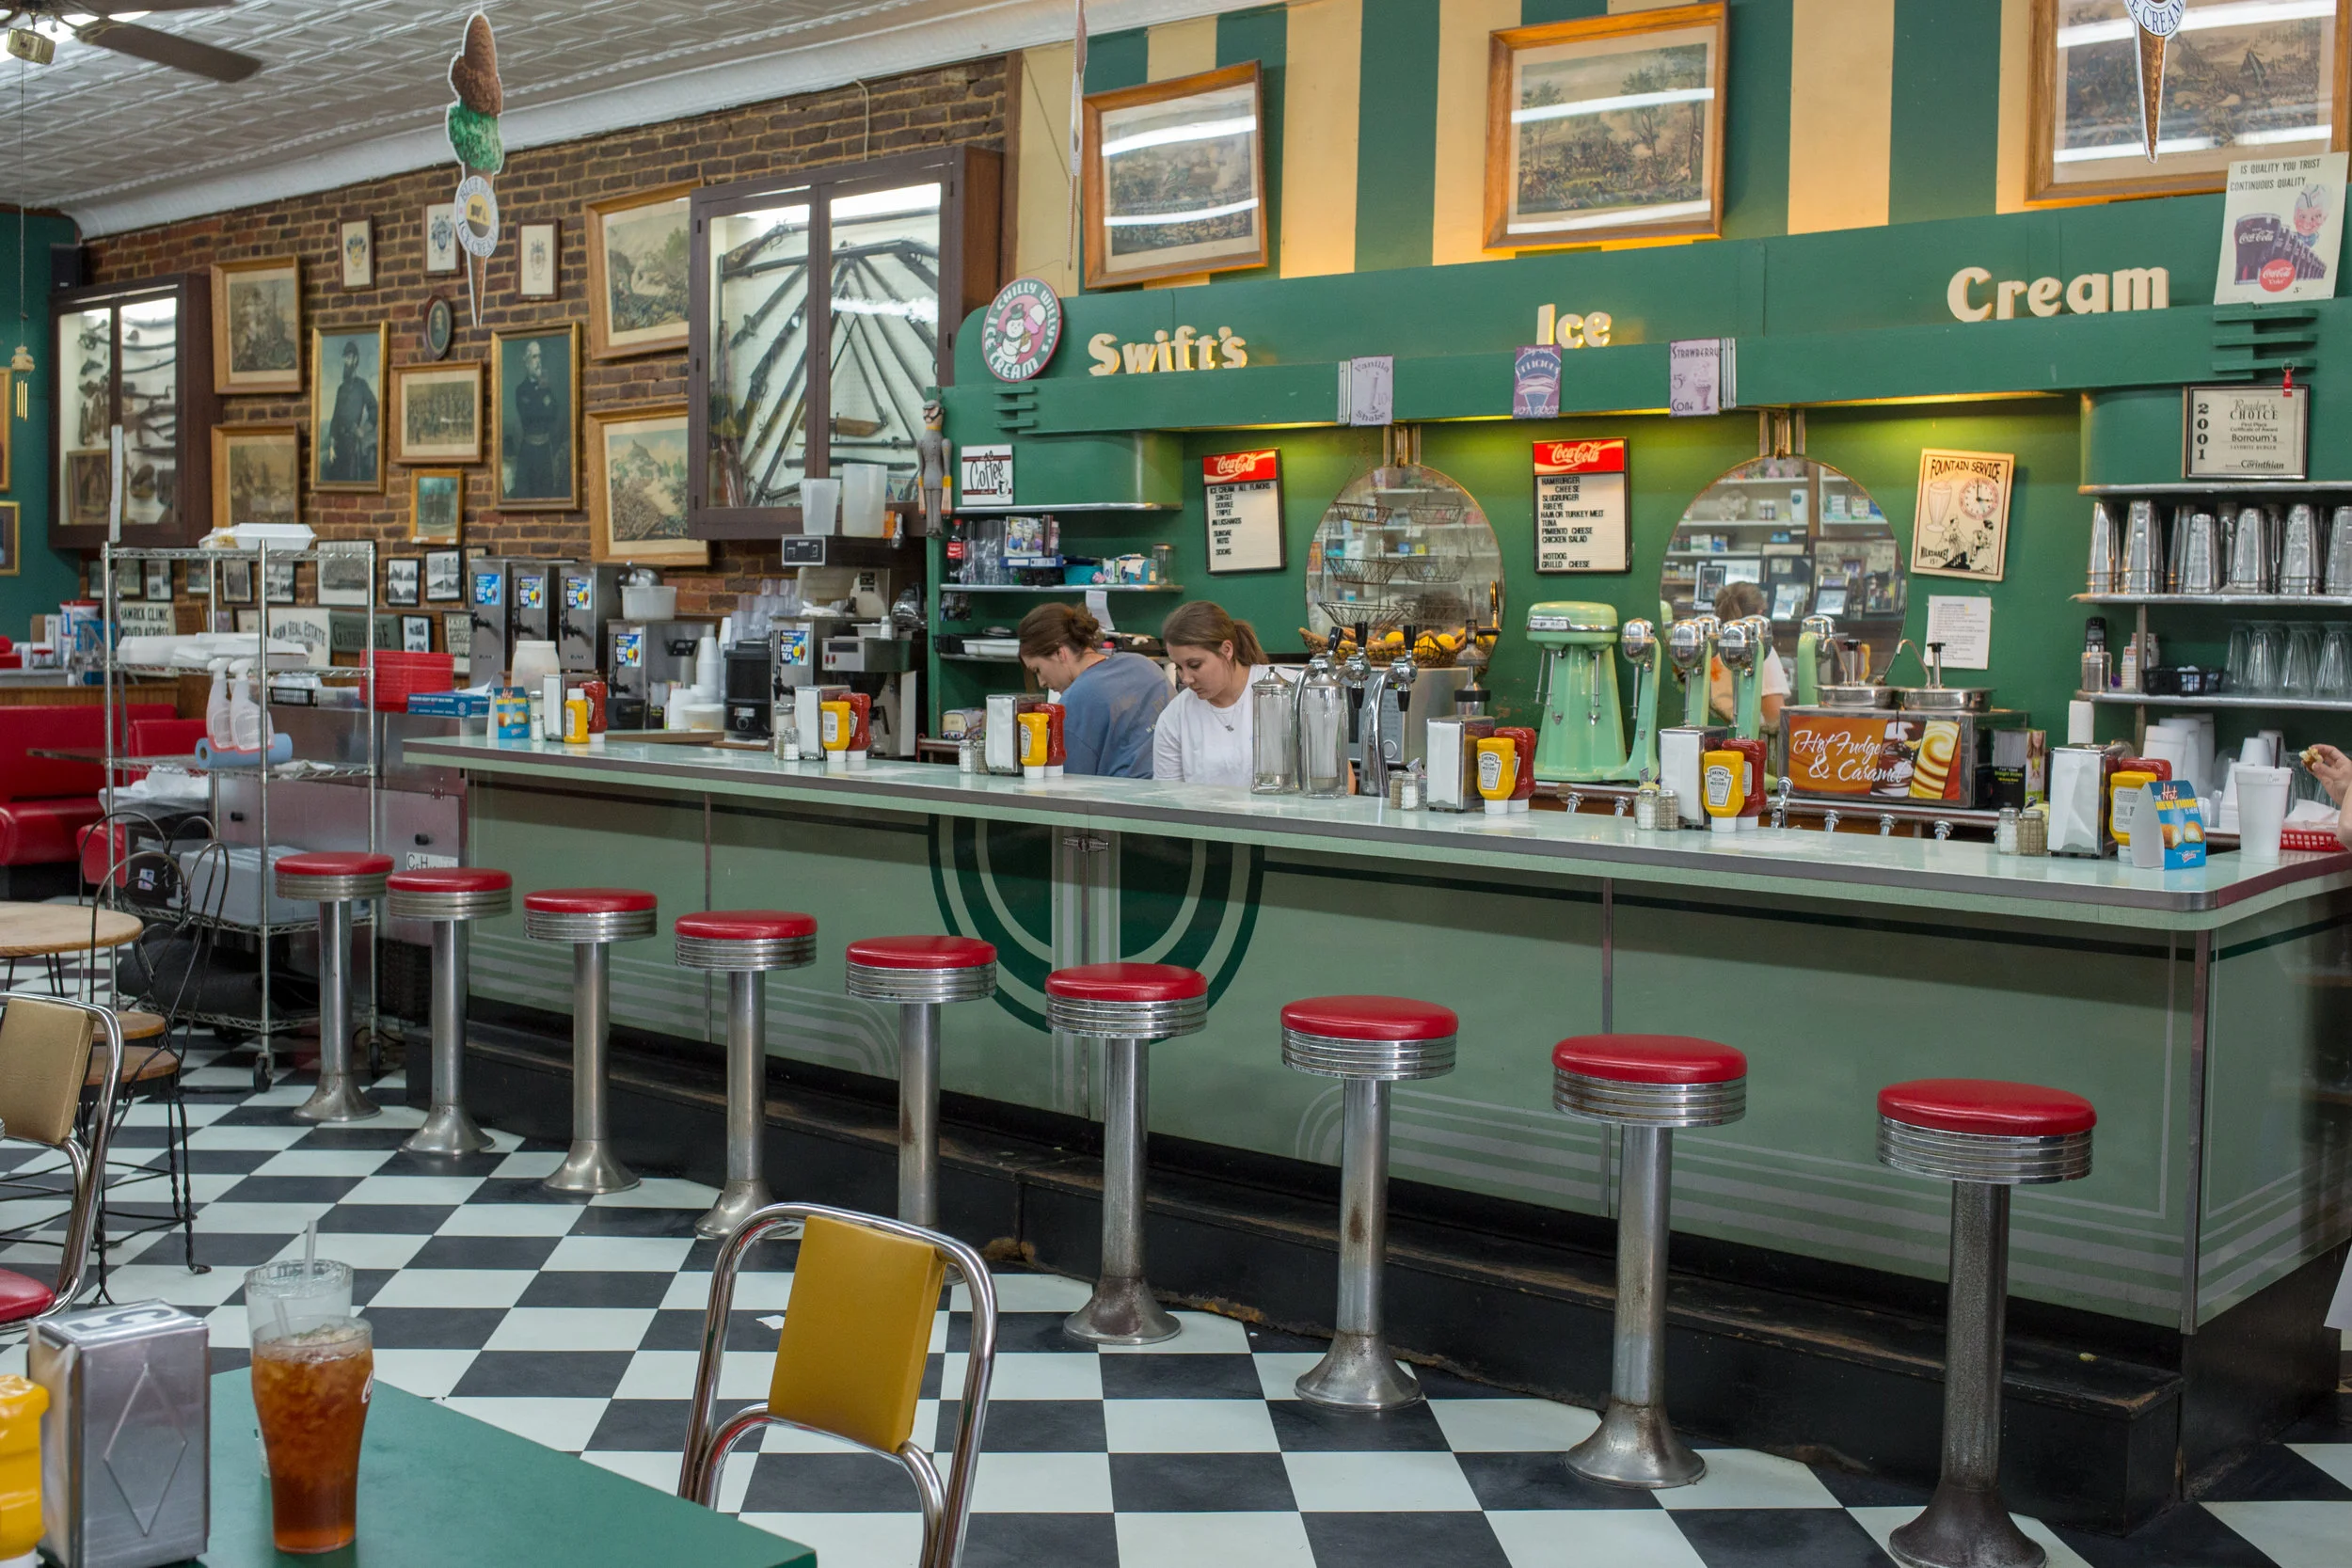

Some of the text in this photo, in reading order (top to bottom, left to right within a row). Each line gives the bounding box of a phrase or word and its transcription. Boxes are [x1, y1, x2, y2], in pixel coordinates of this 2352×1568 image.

[2142, 0, 2183, 33] CREAM
[2240, 158, 2322, 174] IS QUALITY YOU TRUST
[2230, 177, 2307, 192] CONTINUOUS QUALITY
[1947, 266, 2170, 323] Cream
[996, 282, 1057, 353] CHILLY WILLY'S
[1536, 303, 1612, 349] Ice
[985, 316, 1040, 380] ICE CREAM
[1088, 325, 1248, 377] Swift's
[1672, 345, 1720, 359] STRAWBERRY
[1354, 359, 1390, 373] Vanilla
[1356, 409, 1386, 422] Shake
[2230, 410, 2279, 420] CHOICE
[2234, 399, 2276, 414] Reader's
[2232, 434, 2278, 442] Borroum's
[1549, 443, 1600, 464] Coca-Cola
[970, 450, 1005, 491] Coffee
[1216, 453, 1257, 474] Coca-Cola
[1930, 458, 2001, 483] FOUNTAIN SERVICE
[2240, 460, 2284, 469] Corinthian
[1542, 476, 1581, 484] HAMBURGER
[304, 621, 326, 646] ESTATE
[781, 643, 793, 653] ICED
[782, 652, 792, 660] TEA
[1793, 730, 1881, 765] Hot Fudge
[1808, 753, 1908, 784] & Caramel
[2161, 783, 2178, 800] Hot
